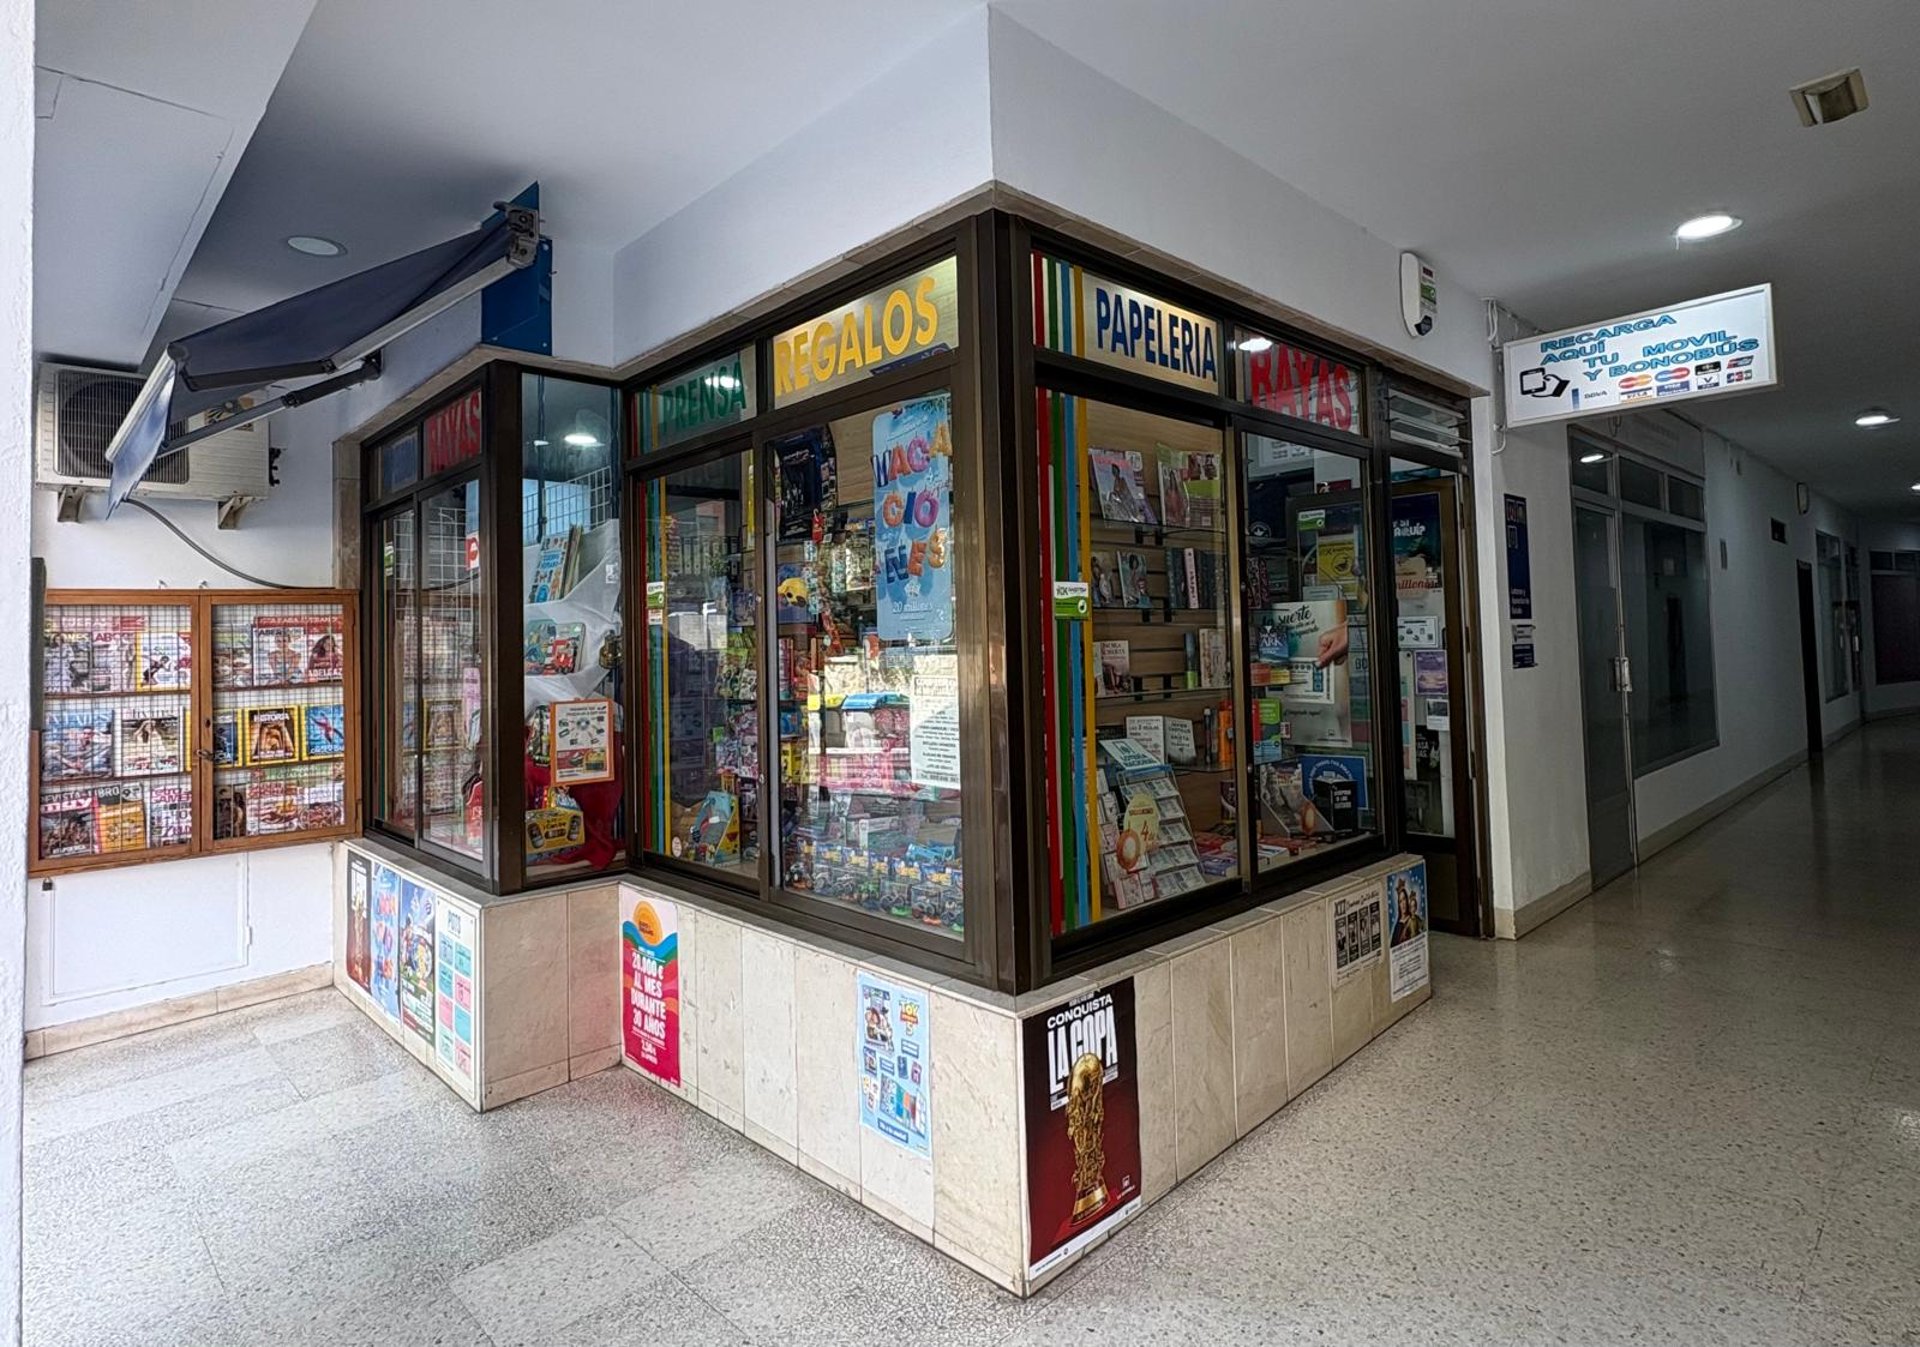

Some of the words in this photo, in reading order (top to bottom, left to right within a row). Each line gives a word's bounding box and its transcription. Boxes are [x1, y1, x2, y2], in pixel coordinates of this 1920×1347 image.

[773, 275, 939, 397] REGALOS
[1095, 286, 1217, 383] PAPELERIA
[1540, 315, 1677, 353] RECARGA
[1540, 340, 1606, 365] AQUÍ
[1583, 352, 1620, 369] TU
[1642, 330, 1738, 357] MOVIL
[1583, 368, 1604, 381] Y
[1608, 338, 1760, 377] BONOBÚS
[660, 356, 747, 436] PRENSA
[1249, 342, 1352, 432] RAYAS
[1278, 604, 1312, 625] suerte
[633, 968, 644, 991] AL
[643, 974, 663, 999] MES
[630, 986, 667, 1021] DURANTE
[1047, 993, 1113, 1029] CONQUISTA
[643, 1013, 667, 1040] AÑOS
[1047, 1025, 1070, 1095] LA
[1069, 1004, 1118, 1068] COPA
